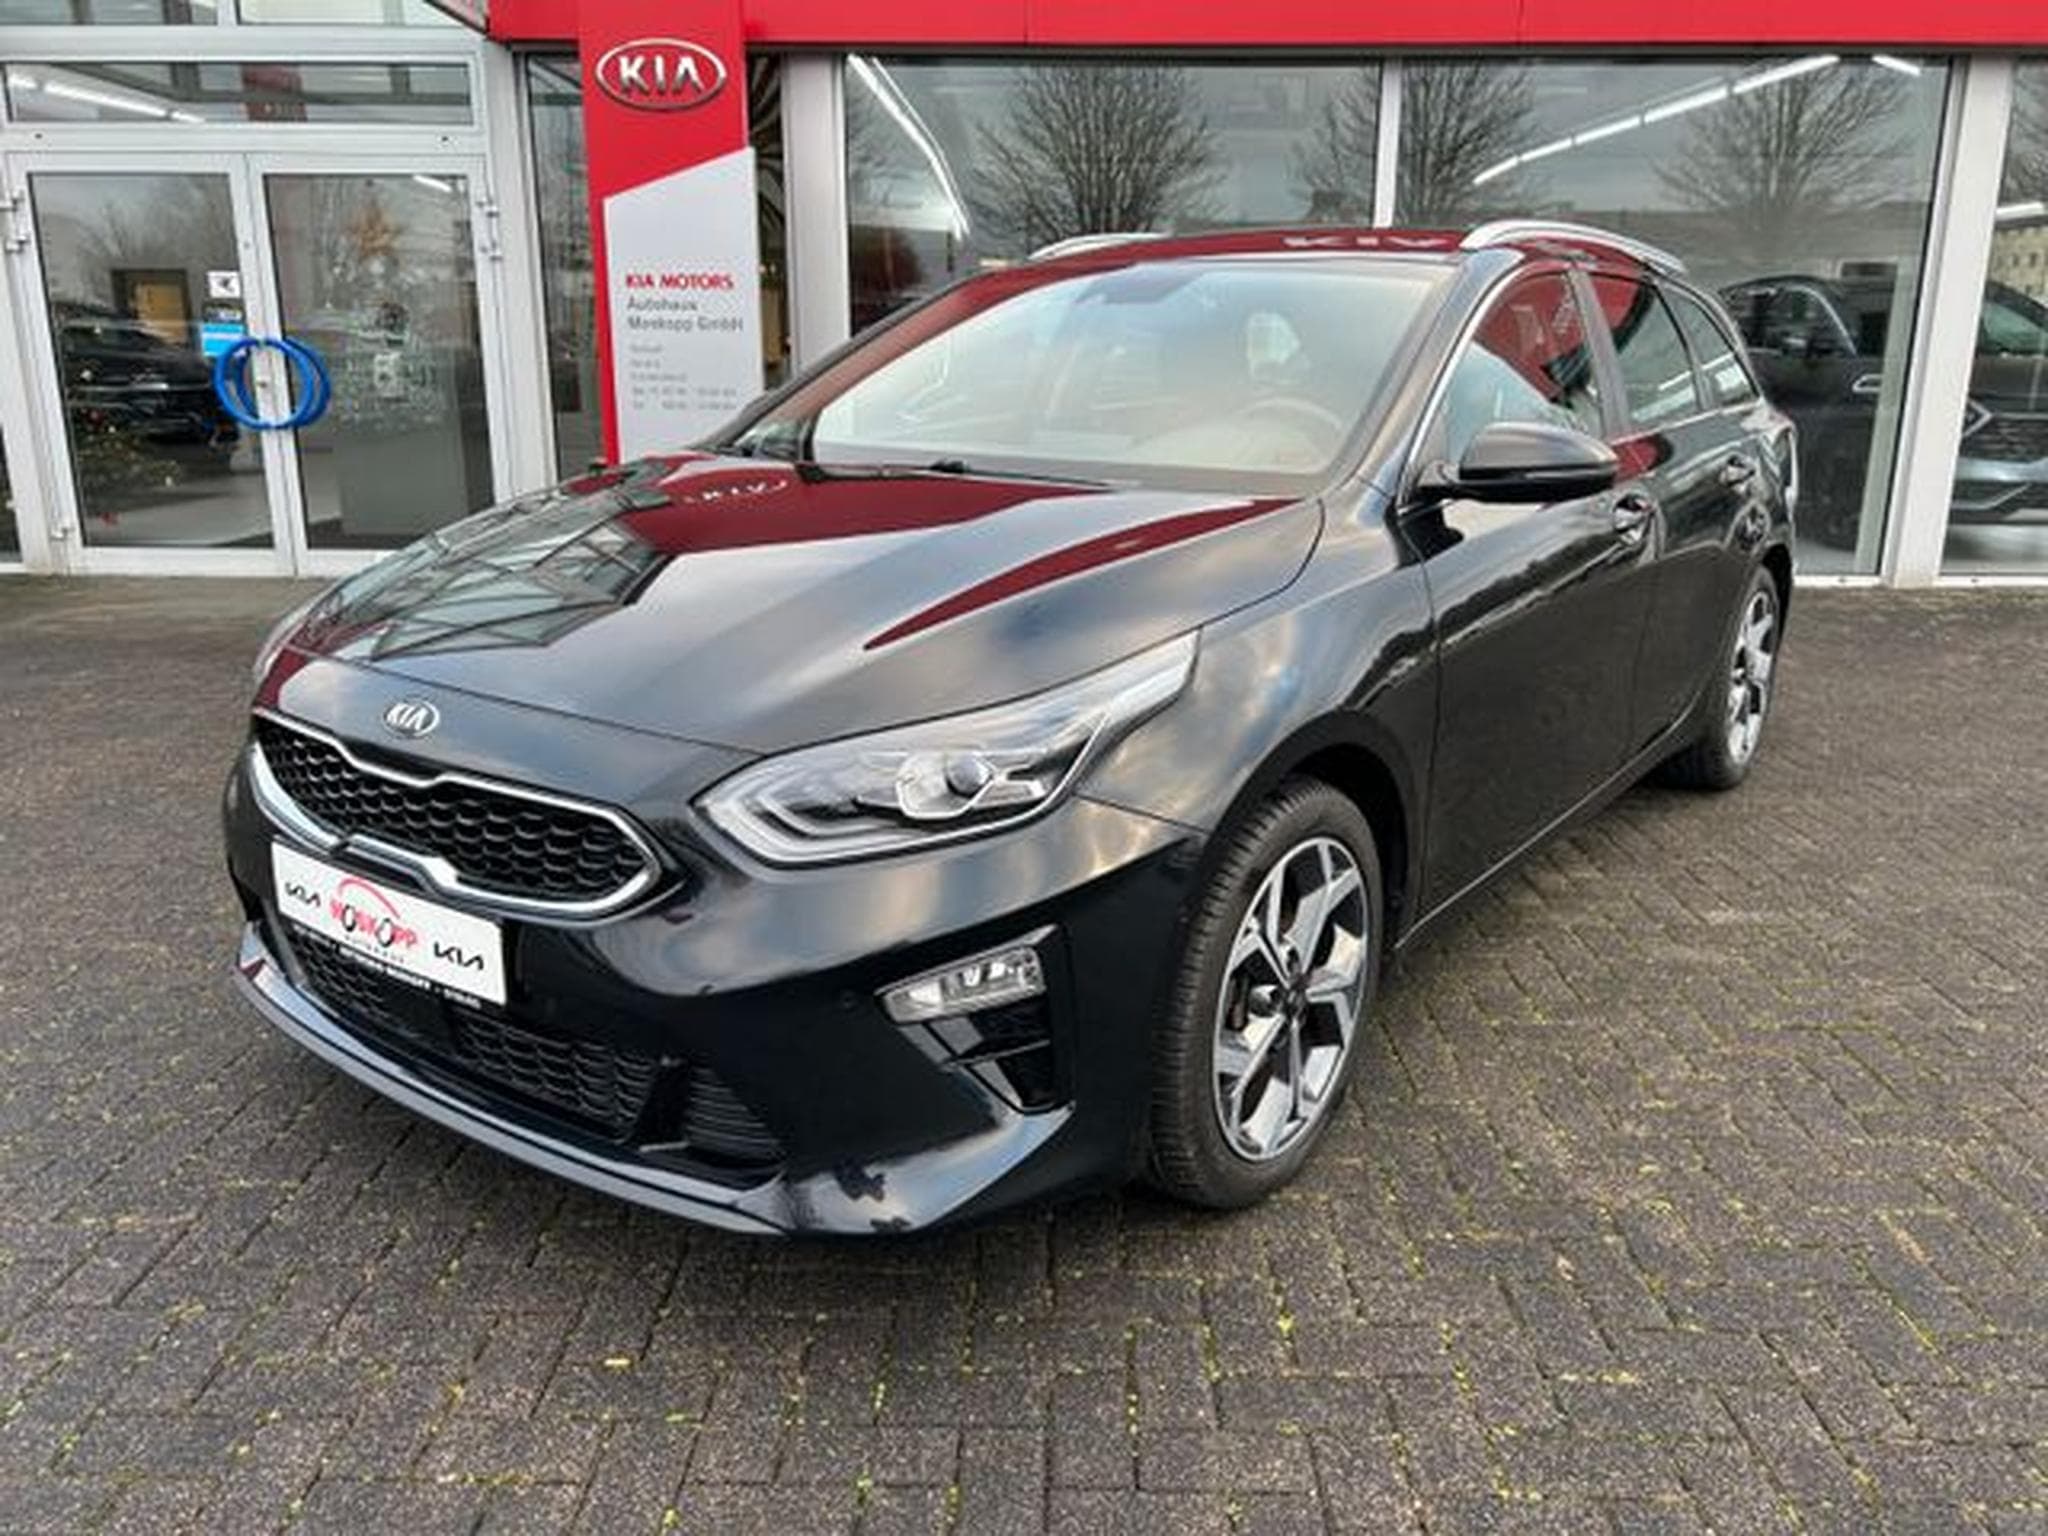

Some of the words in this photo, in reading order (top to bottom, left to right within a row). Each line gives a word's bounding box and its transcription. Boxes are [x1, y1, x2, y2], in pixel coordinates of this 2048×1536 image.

[618, 55, 705, 96] KIA
[625, 273, 655, 289] KIA
[659, 273, 735, 290] MOTORS
[626, 296, 698, 312] Autohaus
[697, 316, 744, 332] GmbH
[386, 702, 429, 731] KIA
[433, 940, 485, 971] KIA
